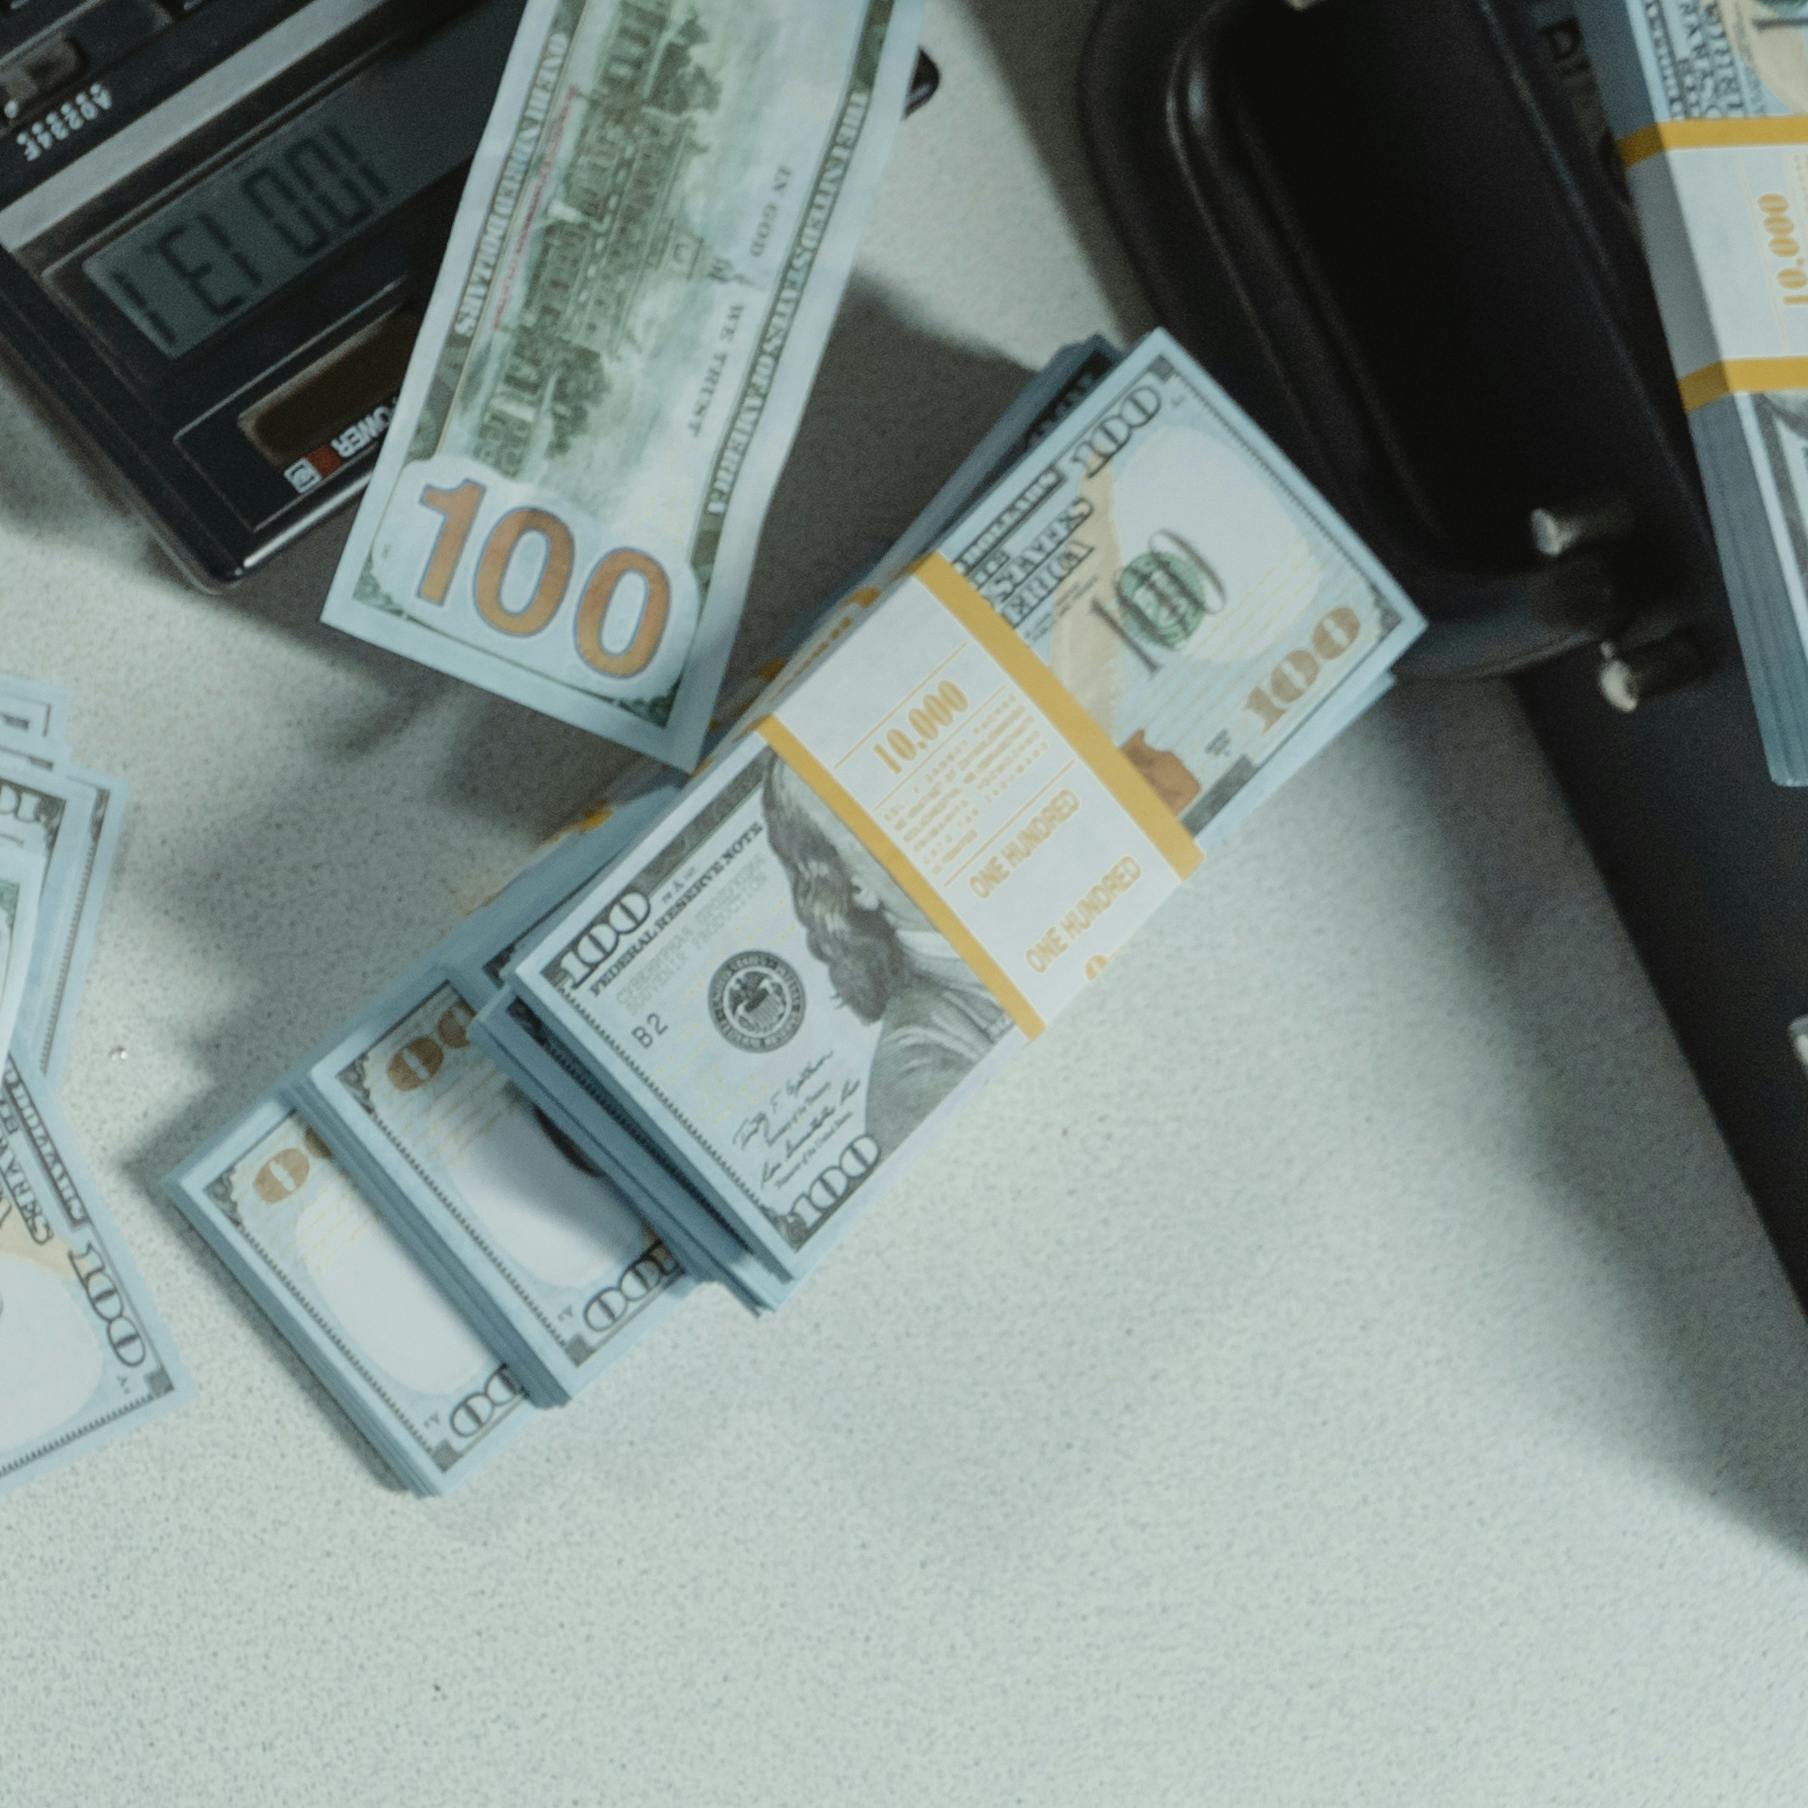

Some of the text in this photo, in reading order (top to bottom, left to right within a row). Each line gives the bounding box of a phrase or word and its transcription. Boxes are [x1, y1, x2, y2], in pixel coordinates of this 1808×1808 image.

[685, 163, 794, 439] IN GOD WE TRUST
[331, 400, 393, 458] OWER
[1066, 381, 1166, 480] 100
[415, 479, 673, 678] 100
[1236, 603, 1369, 733] 100
[963, 786, 1085, 900] ONE HUNDRED
[552, 886, 657, 986] 100
[586, 819, 765, 997] FEDERAL RESERVE NOTE
[1020, 853, 1145, 973] ONE HUNDRED
[627, 1008, 671, 1051] B2
[783, 1133, 884, 1231] 100
[60, 1238, 154, 1373] 100
